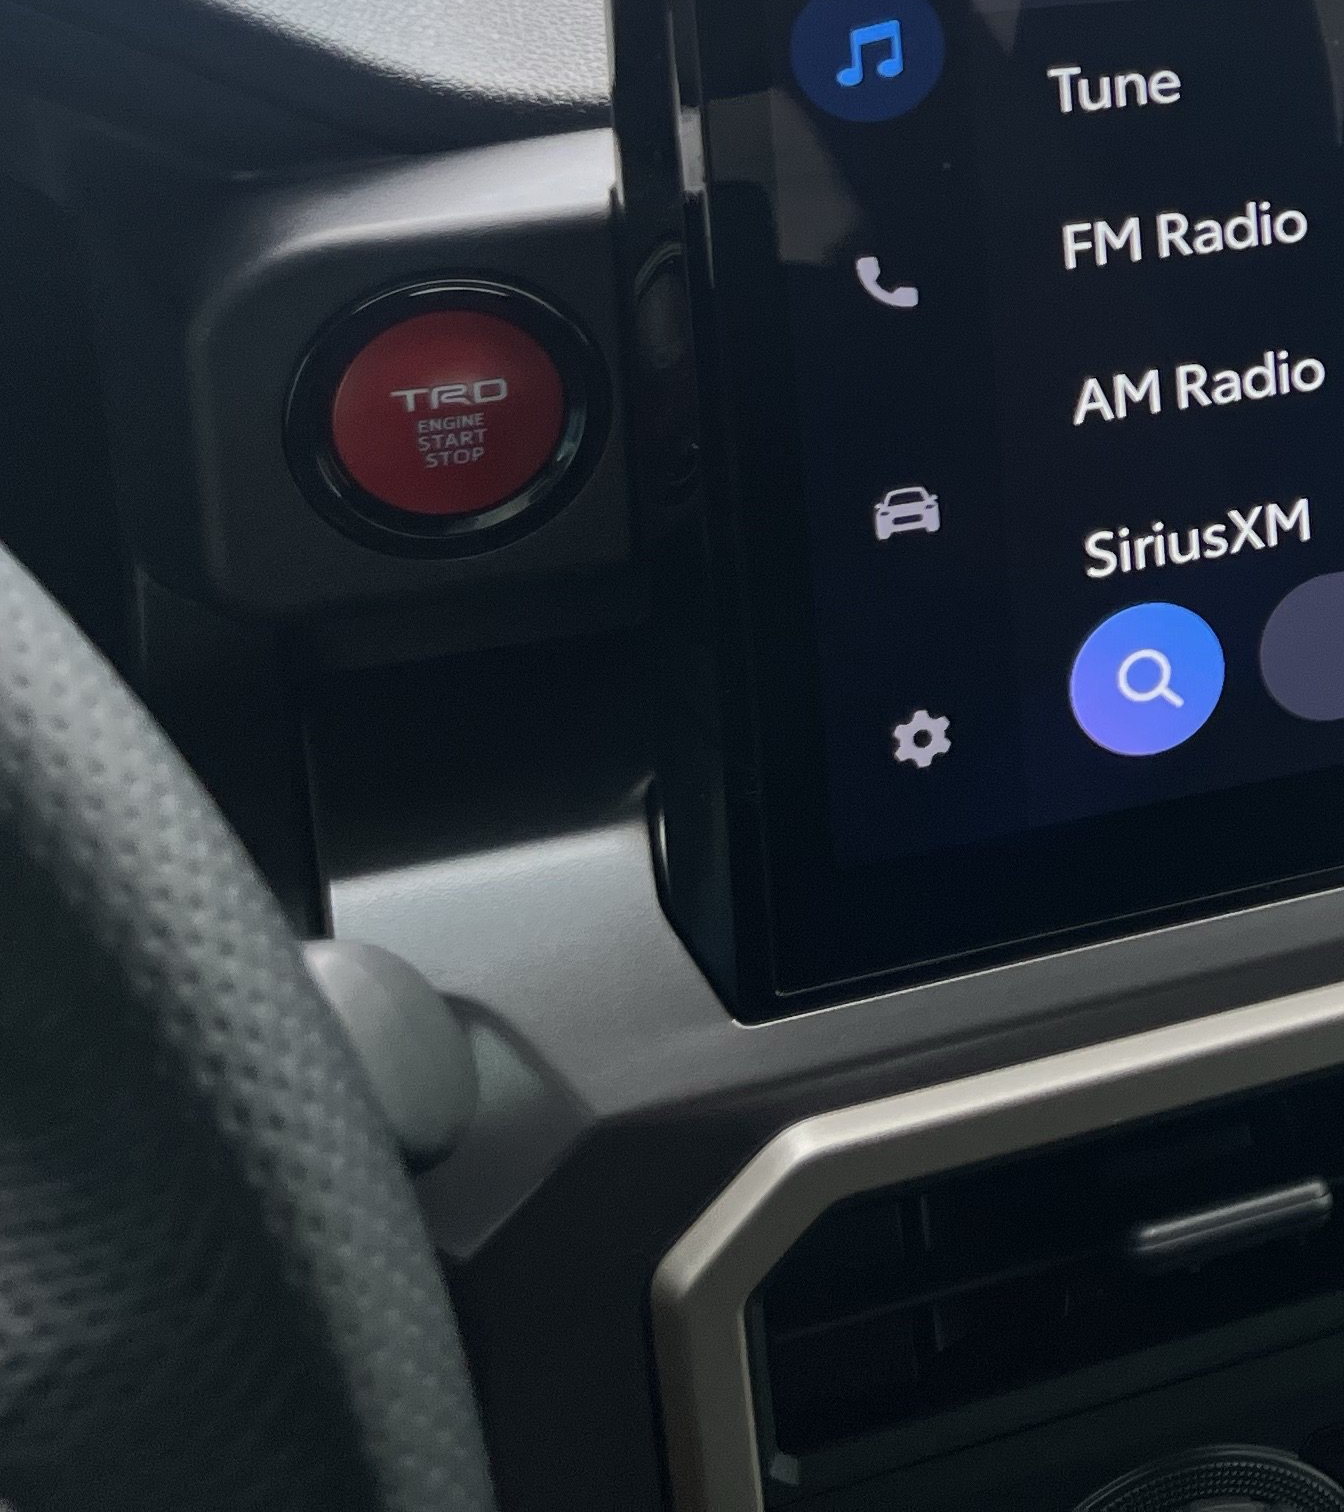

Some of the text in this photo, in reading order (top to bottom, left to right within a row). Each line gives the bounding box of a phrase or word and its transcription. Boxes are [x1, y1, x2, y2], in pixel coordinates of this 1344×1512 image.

[1048, 64, 1182, 114] Tune
[1062, 201, 1309, 270] FM Radio
[389, 377, 509, 413] TRD
[1073, 350, 1326, 426] AM Radio
[417, 412, 485, 433] ENGINE
[417, 428, 488, 453] START
[425, 446, 486, 469] STOP
[1084, 498, 1312, 579] SiriusXM
